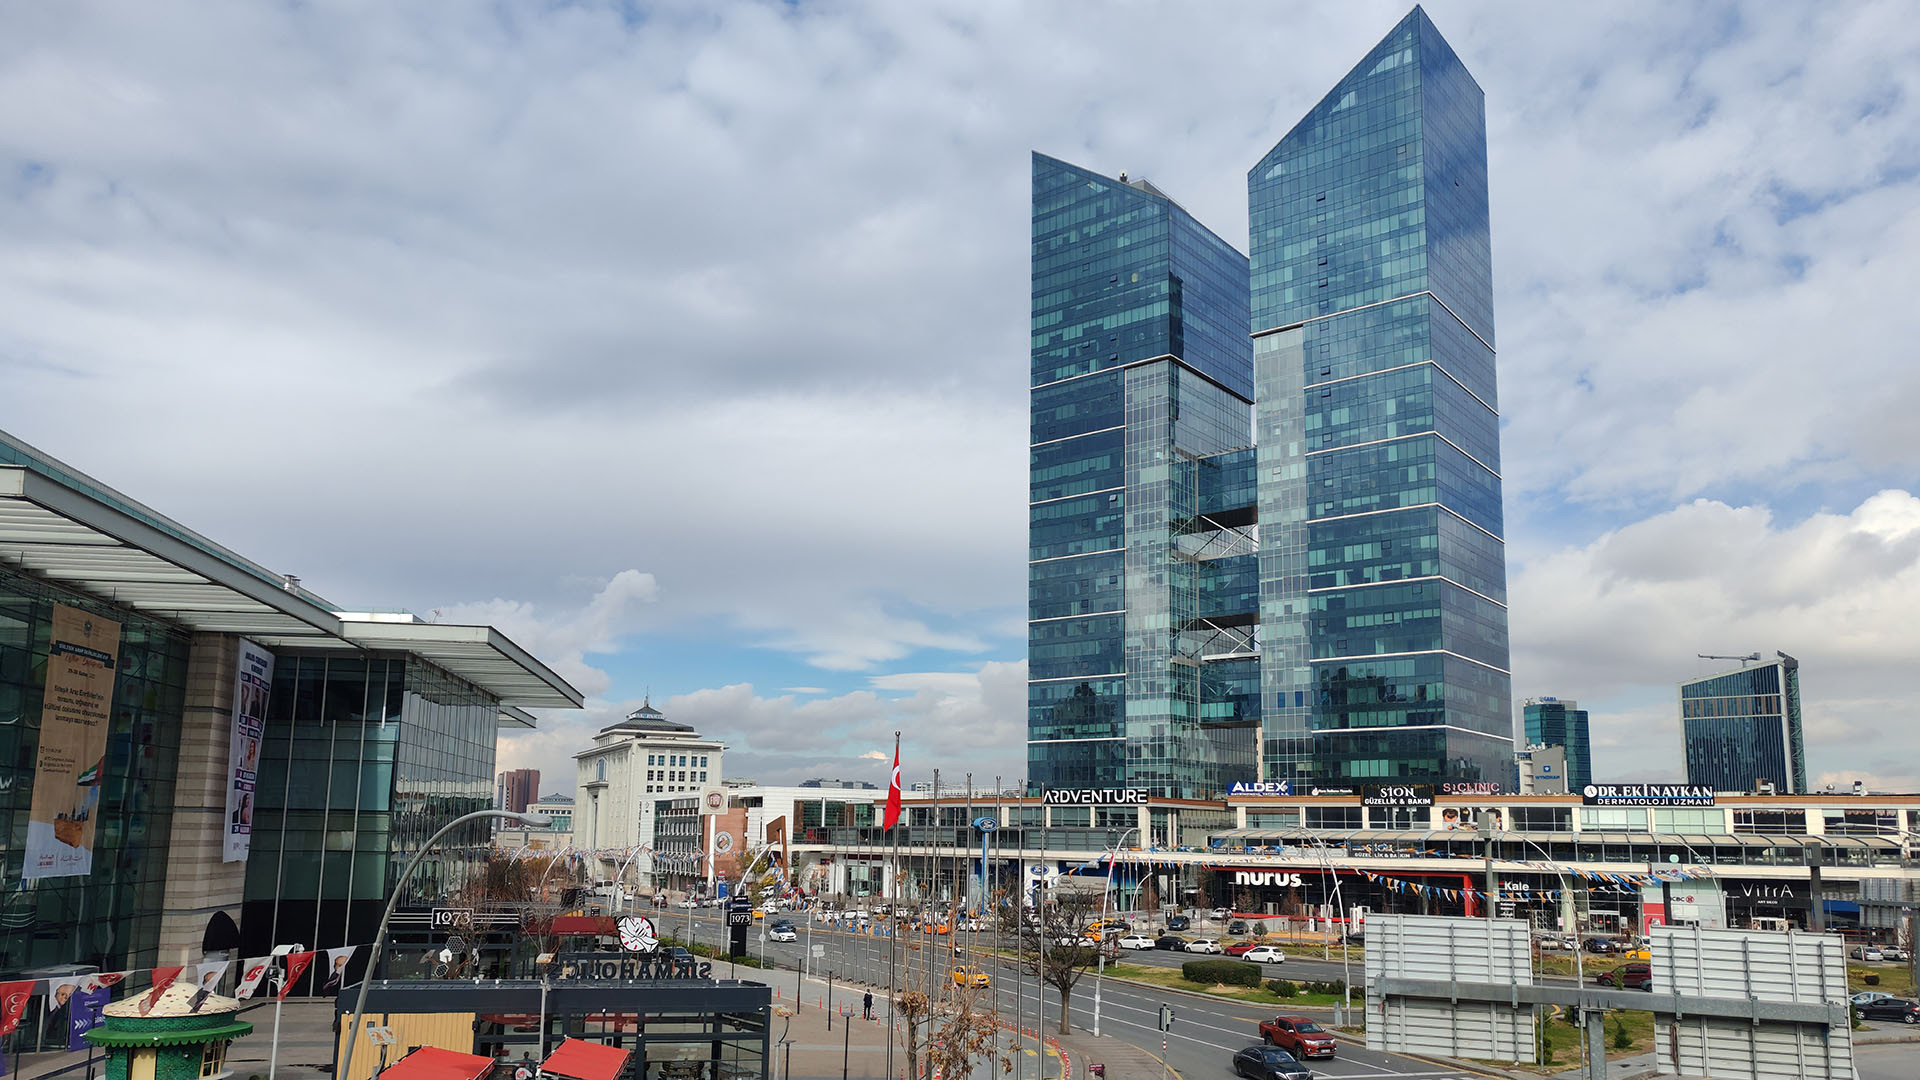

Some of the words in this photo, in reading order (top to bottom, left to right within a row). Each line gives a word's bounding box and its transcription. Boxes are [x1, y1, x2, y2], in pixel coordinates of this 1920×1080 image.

[1231, 780, 1287, 793] ALDEX
[1043, 789, 1148, 804] ARDVENTURE
[1364, 796, 1397, 805] GÜZELLİK
[1236, 871, 1302, 887] nurus
[1504, 881, 1530, 891] Kale
[434, 911, 471, 927] 1073
[731, 915, 750, 923] 1073
